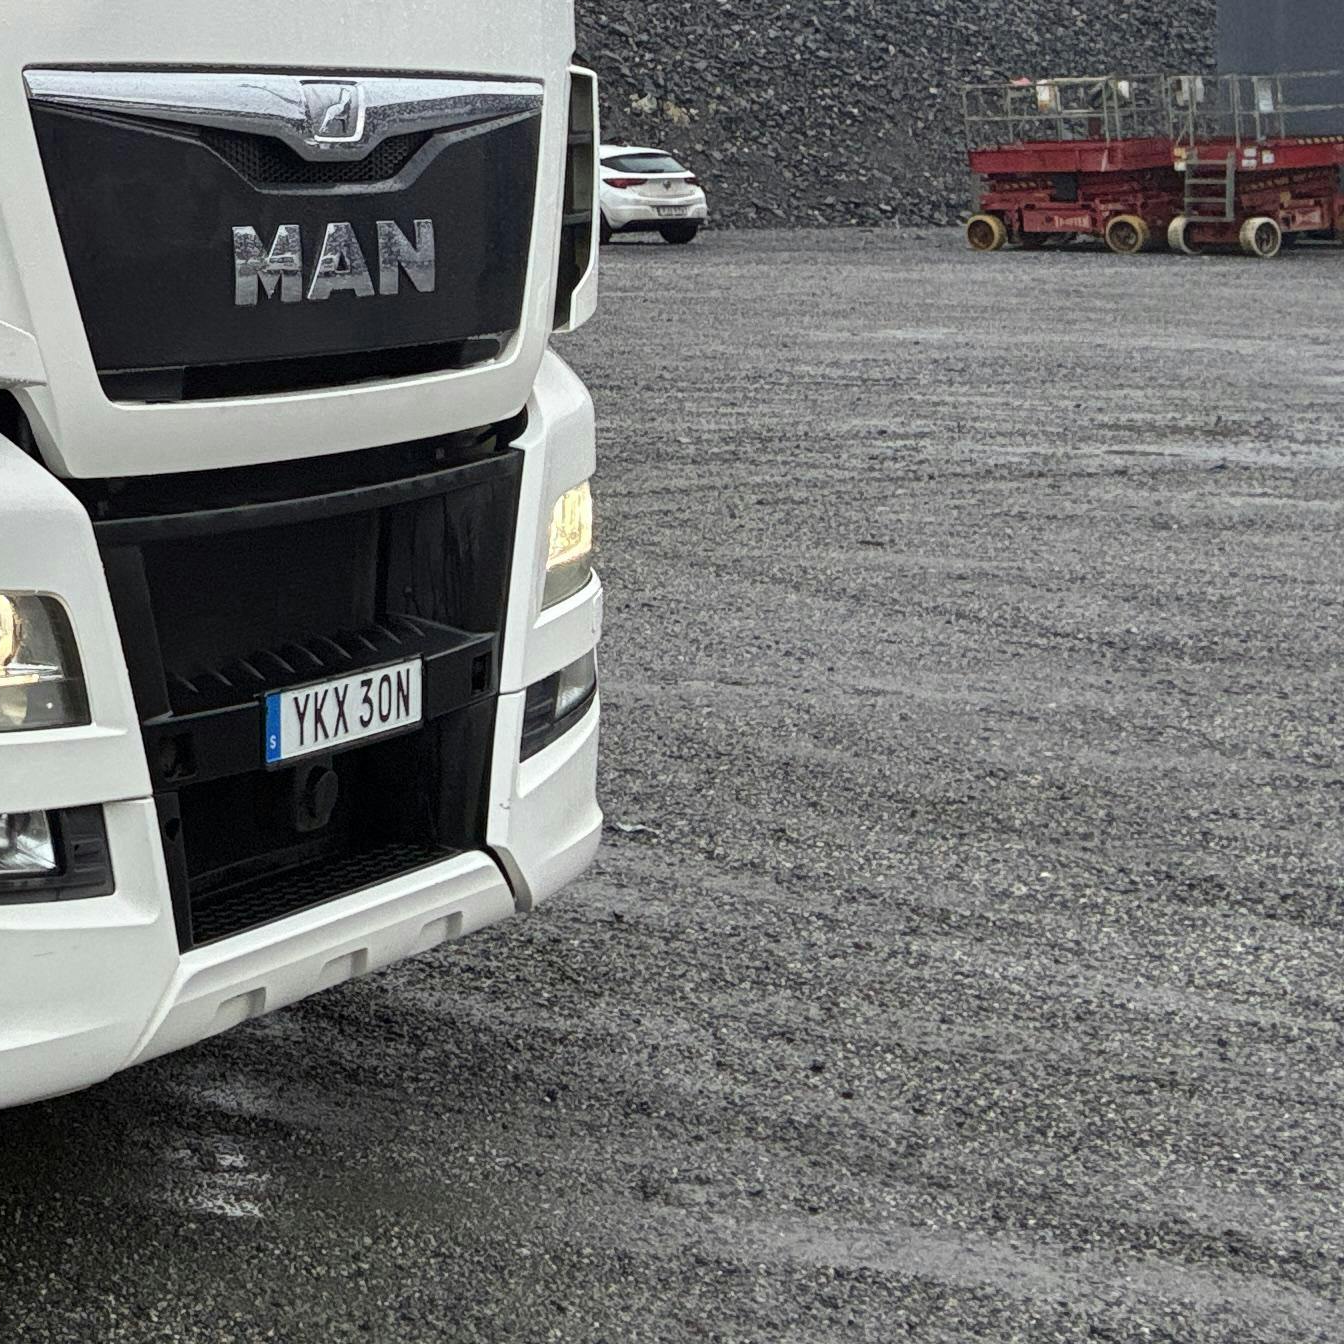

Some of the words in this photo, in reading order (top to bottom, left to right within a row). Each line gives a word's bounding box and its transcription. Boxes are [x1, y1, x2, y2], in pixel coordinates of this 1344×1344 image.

[231, 218, 436, 307] MAN
[269, 734, 277, 750] S
[293, 683, 350, 747] YKX
